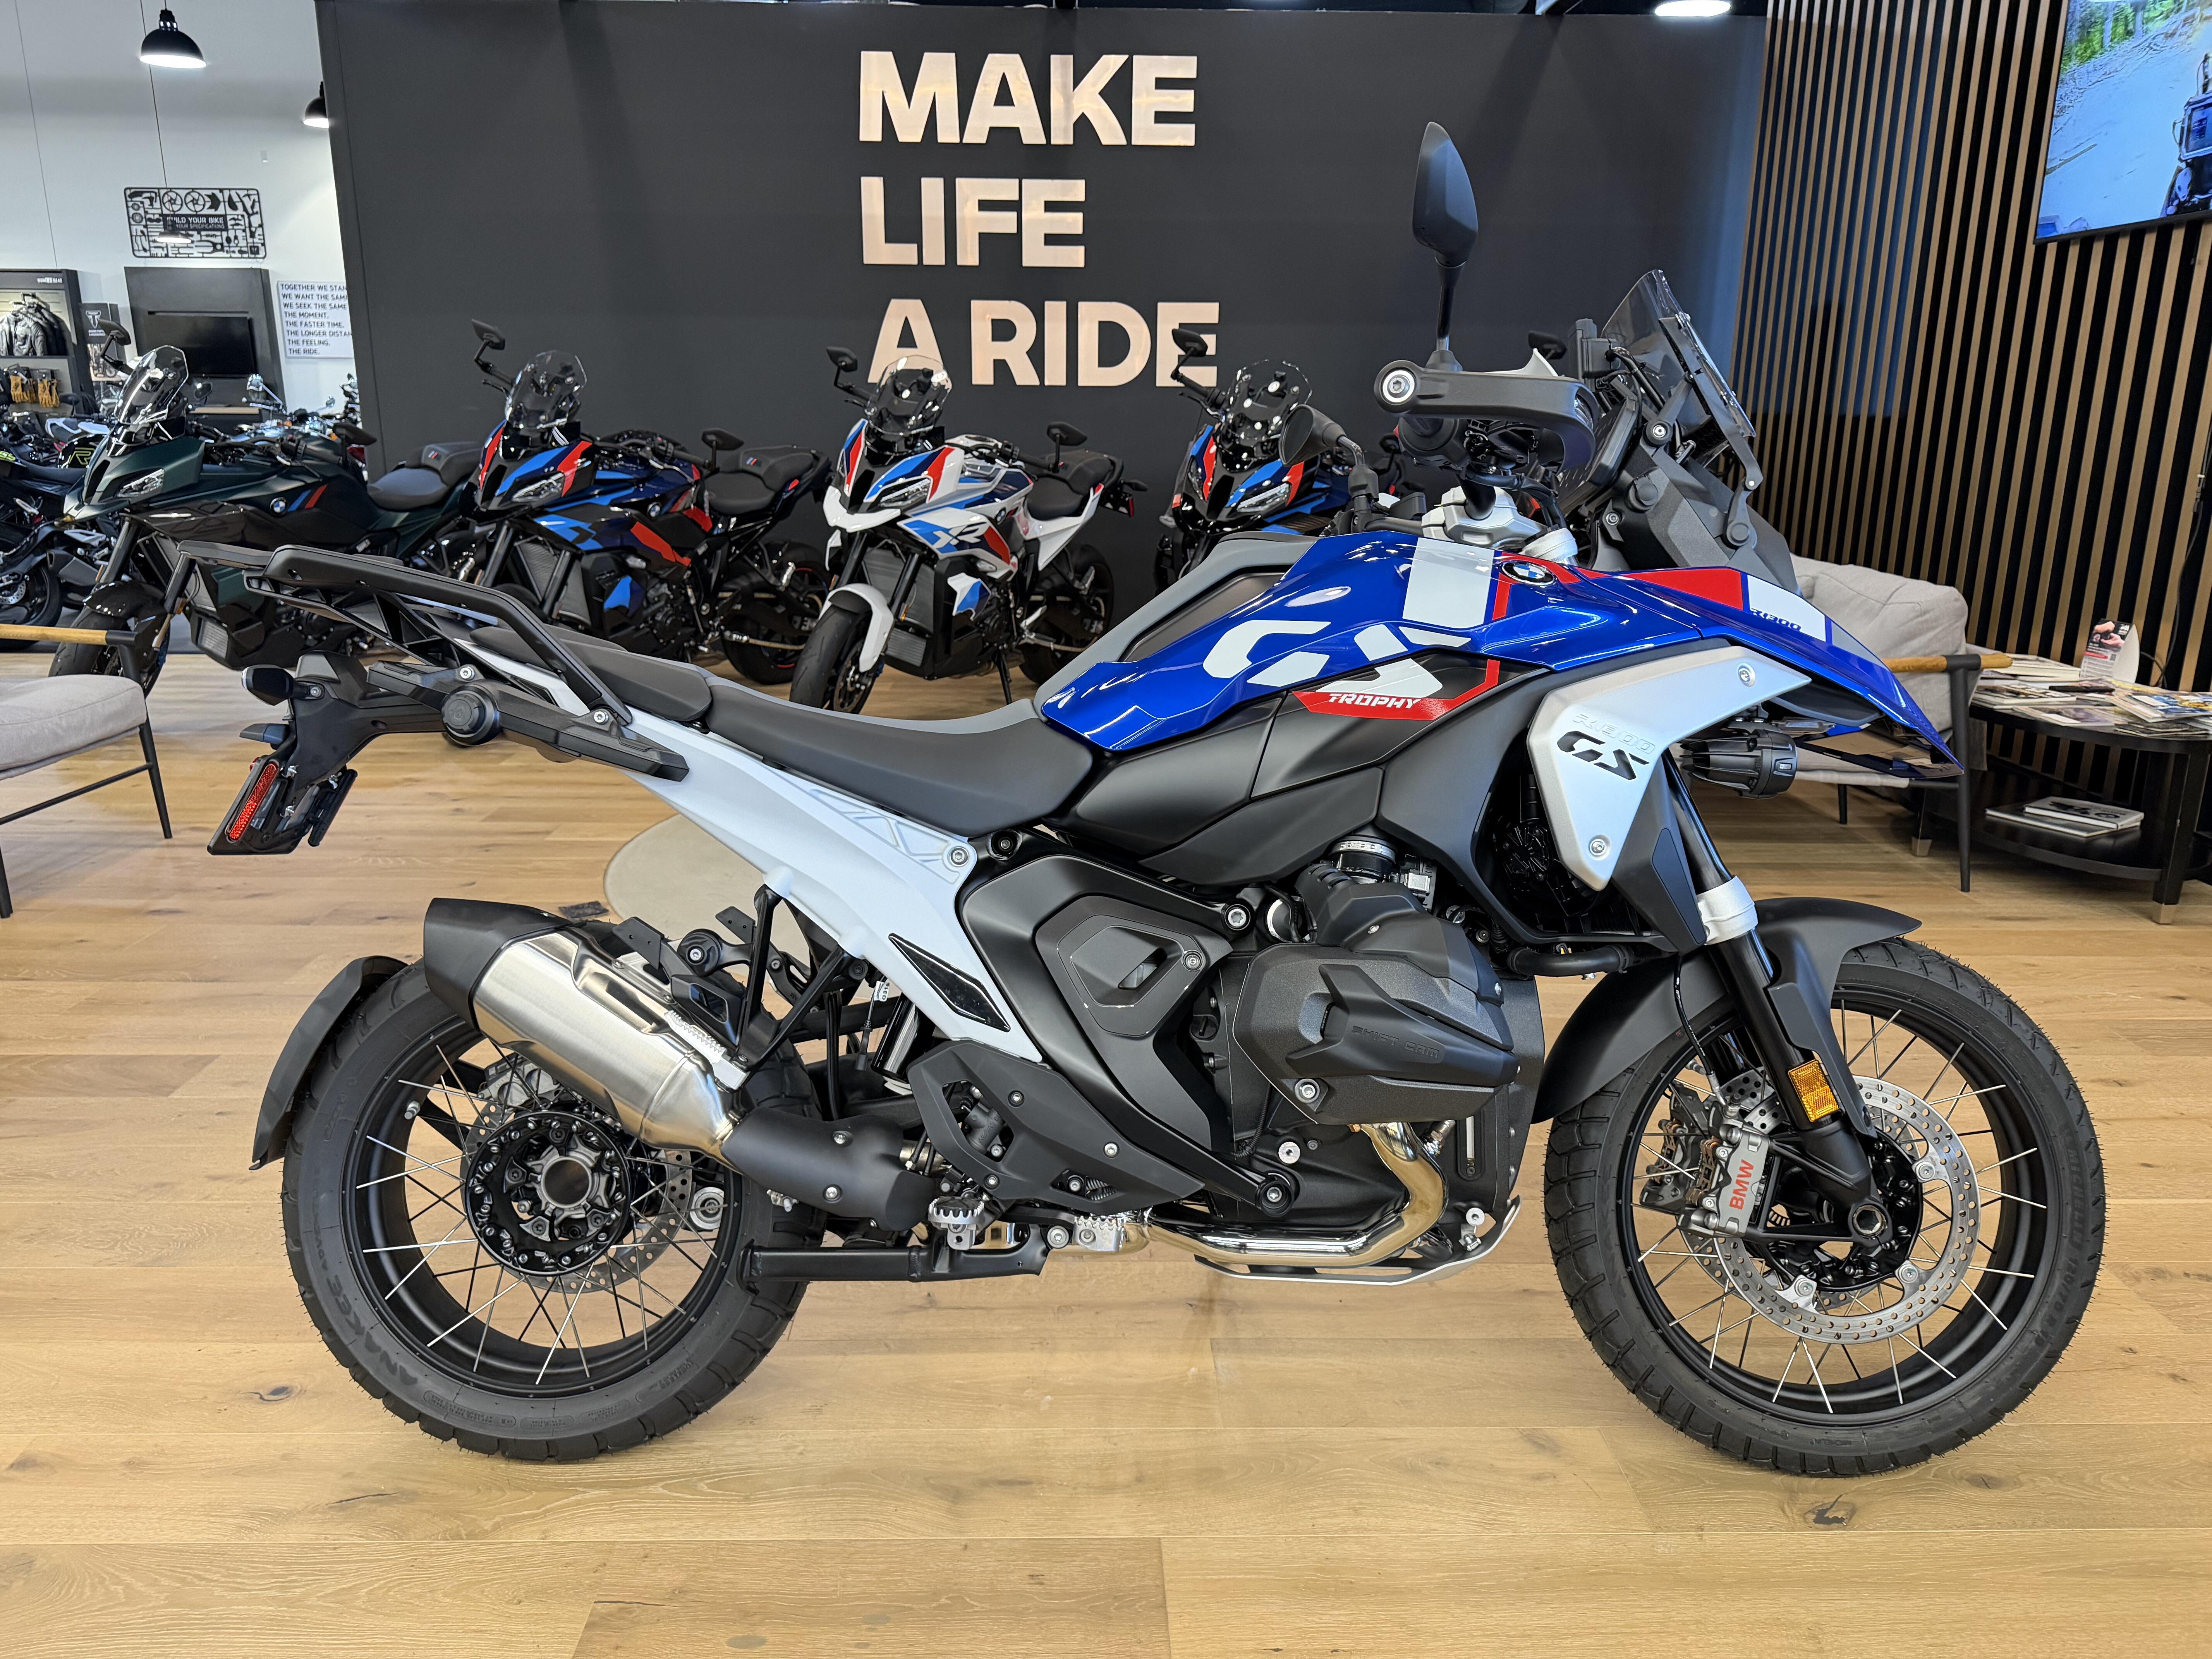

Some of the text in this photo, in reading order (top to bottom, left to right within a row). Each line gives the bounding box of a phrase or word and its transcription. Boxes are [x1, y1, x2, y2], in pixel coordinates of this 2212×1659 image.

[859, 51, 1197, 146] MAKE
[860, 176, 1085, 267] LIFE
[867, 299, 1219, 386] A RIDE
[1328, 693, 1421, 709] TROPHY
[1557, 731, 1650, 780] GS
[1573, 714, 1655, 754] R1300
[1352, 1025, 1439, 1058] SHIFT CAM
[1729, 1159, 1754, 1210] BMW
